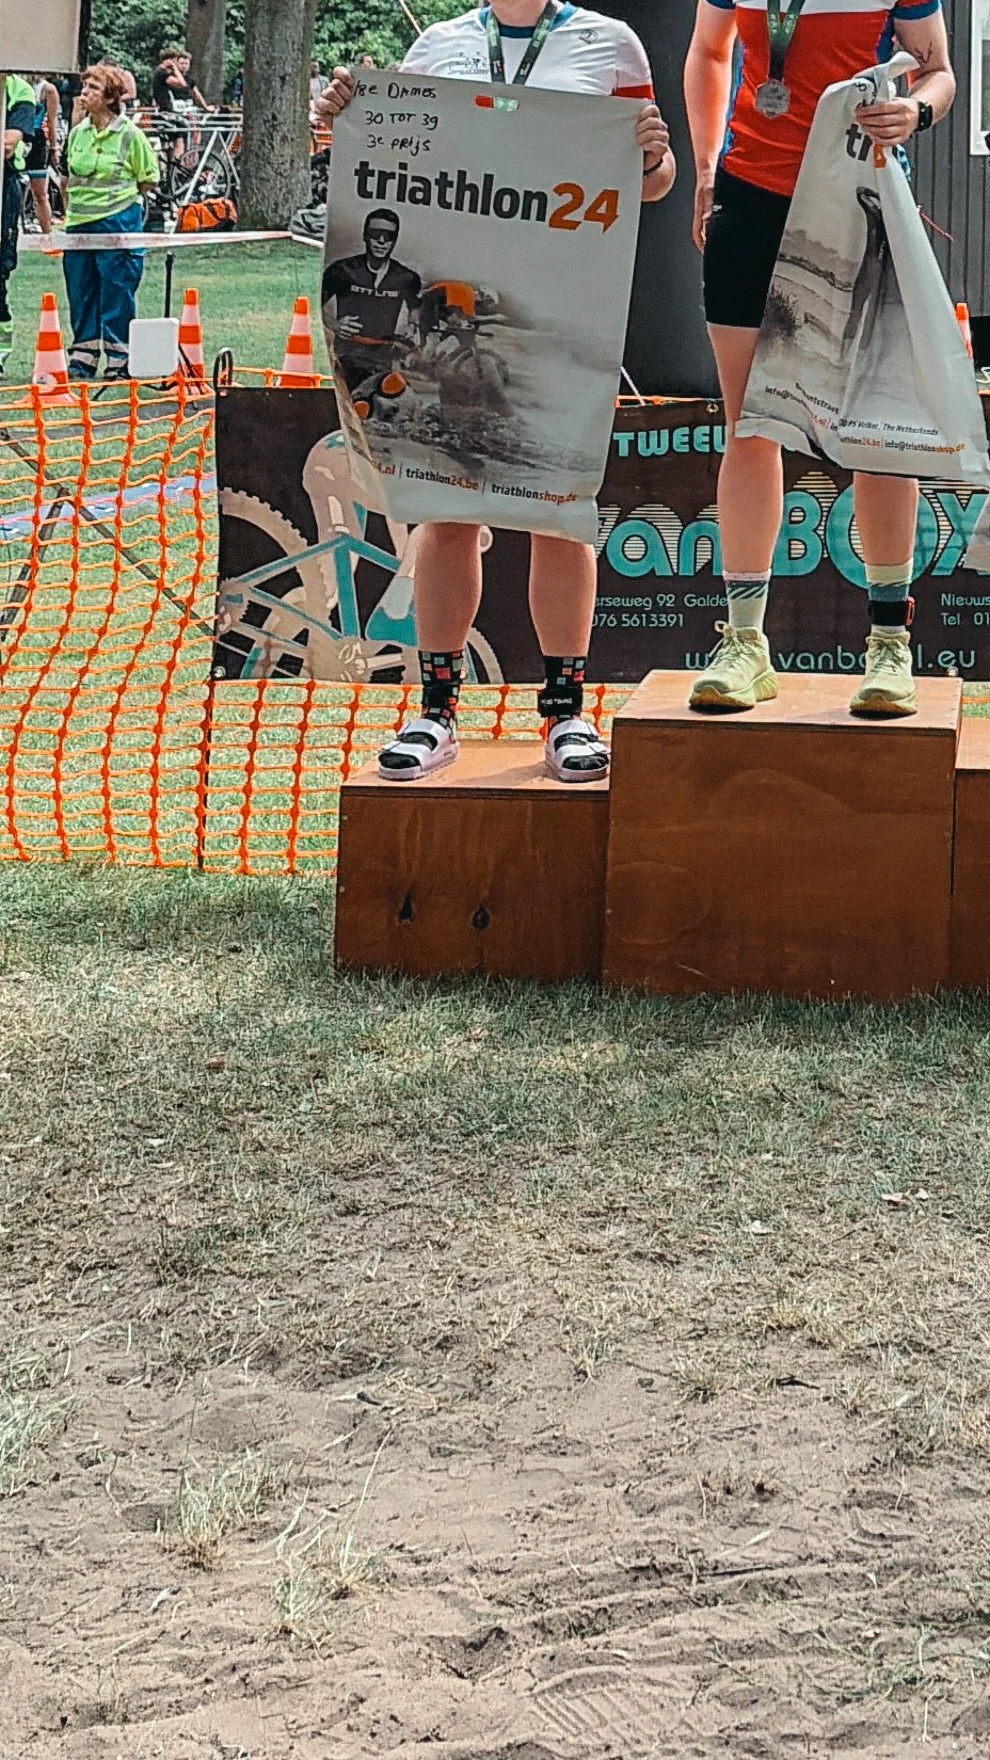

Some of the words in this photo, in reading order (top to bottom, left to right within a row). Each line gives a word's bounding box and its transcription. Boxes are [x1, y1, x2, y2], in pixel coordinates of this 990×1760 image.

[365, 110, 384, 126] 30
[421, 113, 439, 131] 39
[354, 161, 620, 233] triathlon24
[595, 596, 652, 611] erseweg
[656, 593, 676, 608] 92
[683, 593, 728, 608] Galde
[621, 613, 684, 628] 5613391
[941, 612, 961, 626] Tel
